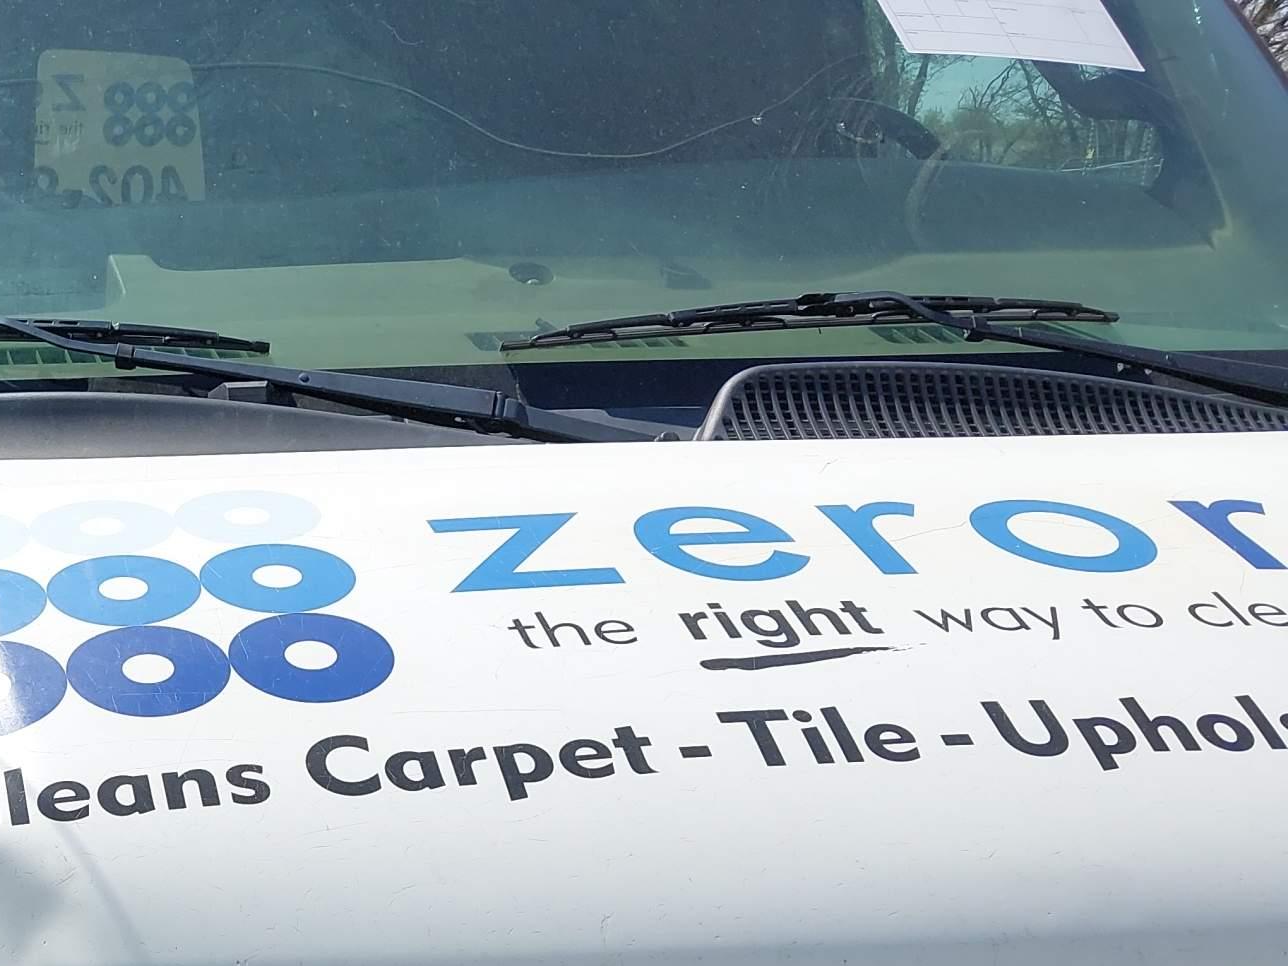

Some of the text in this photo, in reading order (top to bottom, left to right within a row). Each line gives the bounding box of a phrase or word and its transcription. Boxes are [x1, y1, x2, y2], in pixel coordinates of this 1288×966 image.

[508, 612, 637, 650] the
[678, 599, 885, 648] right
[914, 606, 1062, 641] way
[1083, 597, 1165, 630] to
[305, 726, 659, 801] Carpet
[679, 745, 713, 760] -
[717, 706, 921, 767] Tile
[940, 733, 975, 747] -
